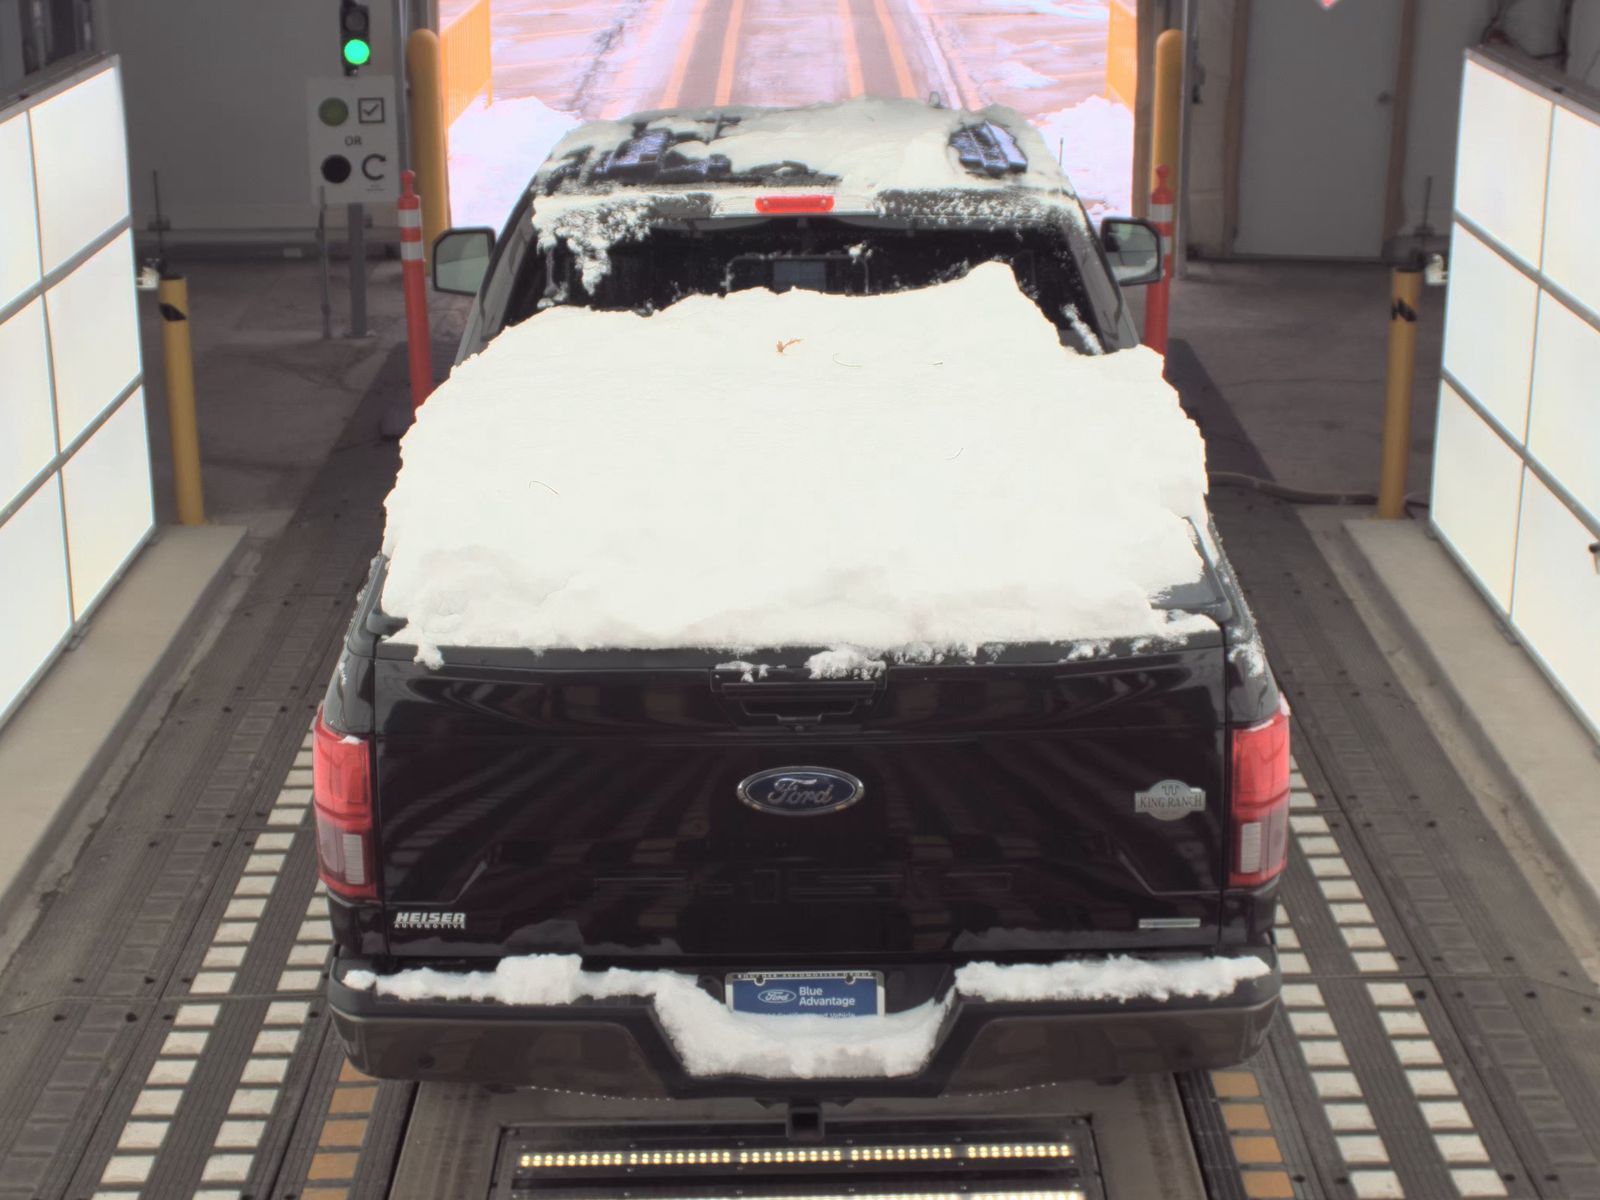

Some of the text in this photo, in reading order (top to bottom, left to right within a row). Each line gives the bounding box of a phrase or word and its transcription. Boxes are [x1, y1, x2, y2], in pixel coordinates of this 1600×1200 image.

[344, 135, 362, 146] OR
[767, 777, 834, 805] Ford
[1139, 794, 1202, 809] KING RANCH
[395, 912, 466, 923] HEISER
[765, 990, 790, 1002] Ford
[799, 986, 823, 996] Blue
[799, 996, 856, 1007] Advantage
